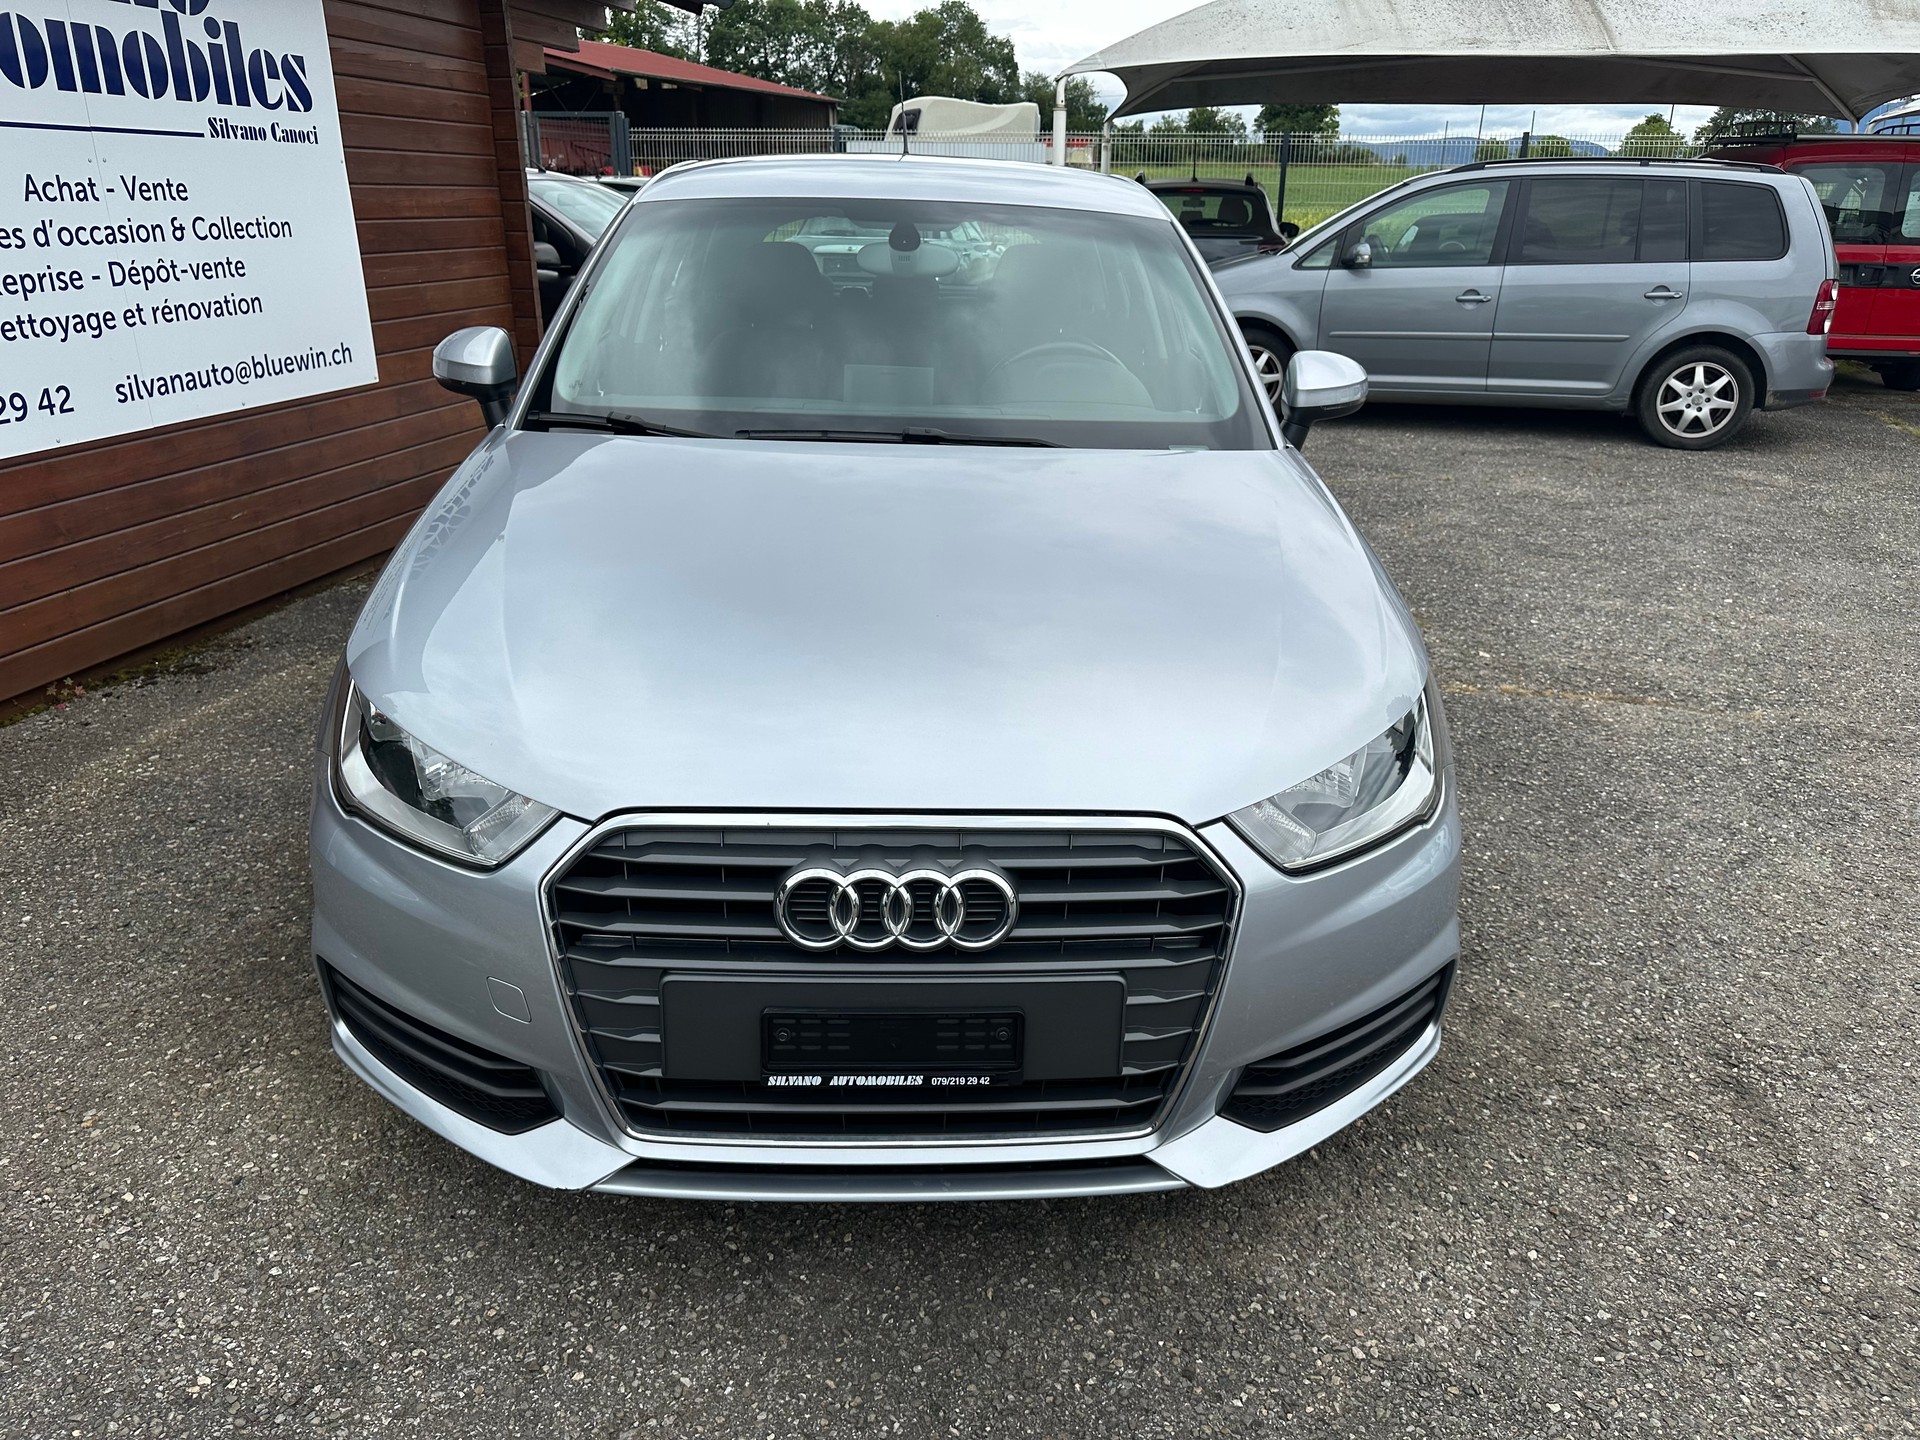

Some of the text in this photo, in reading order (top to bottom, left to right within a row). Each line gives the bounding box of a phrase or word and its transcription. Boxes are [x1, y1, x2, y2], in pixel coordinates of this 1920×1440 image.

[208, 116, 319, 145] Silvano Canoci
[24, 173, 100, 203] Achat
[119, 174, 189, 202] Vente
[32, 218, 165, 248] d'occasion
[170, 216, 186, 242] &
[191, 215, 293, 242] Collection
[0, 264, 85, 301] eprise
[107, 257, 247, 289] Dépôt-vente
[122, 303, 147, 328] et
[151, 294, 264, 325] rénovation
[37, 384, 75, 416] 42
[115, 342, 354, 404] silvanauto@bluewin.ch
[767, 1074, 990, 1086] SILVANO AUTOMOBILES 079/219 29 42
